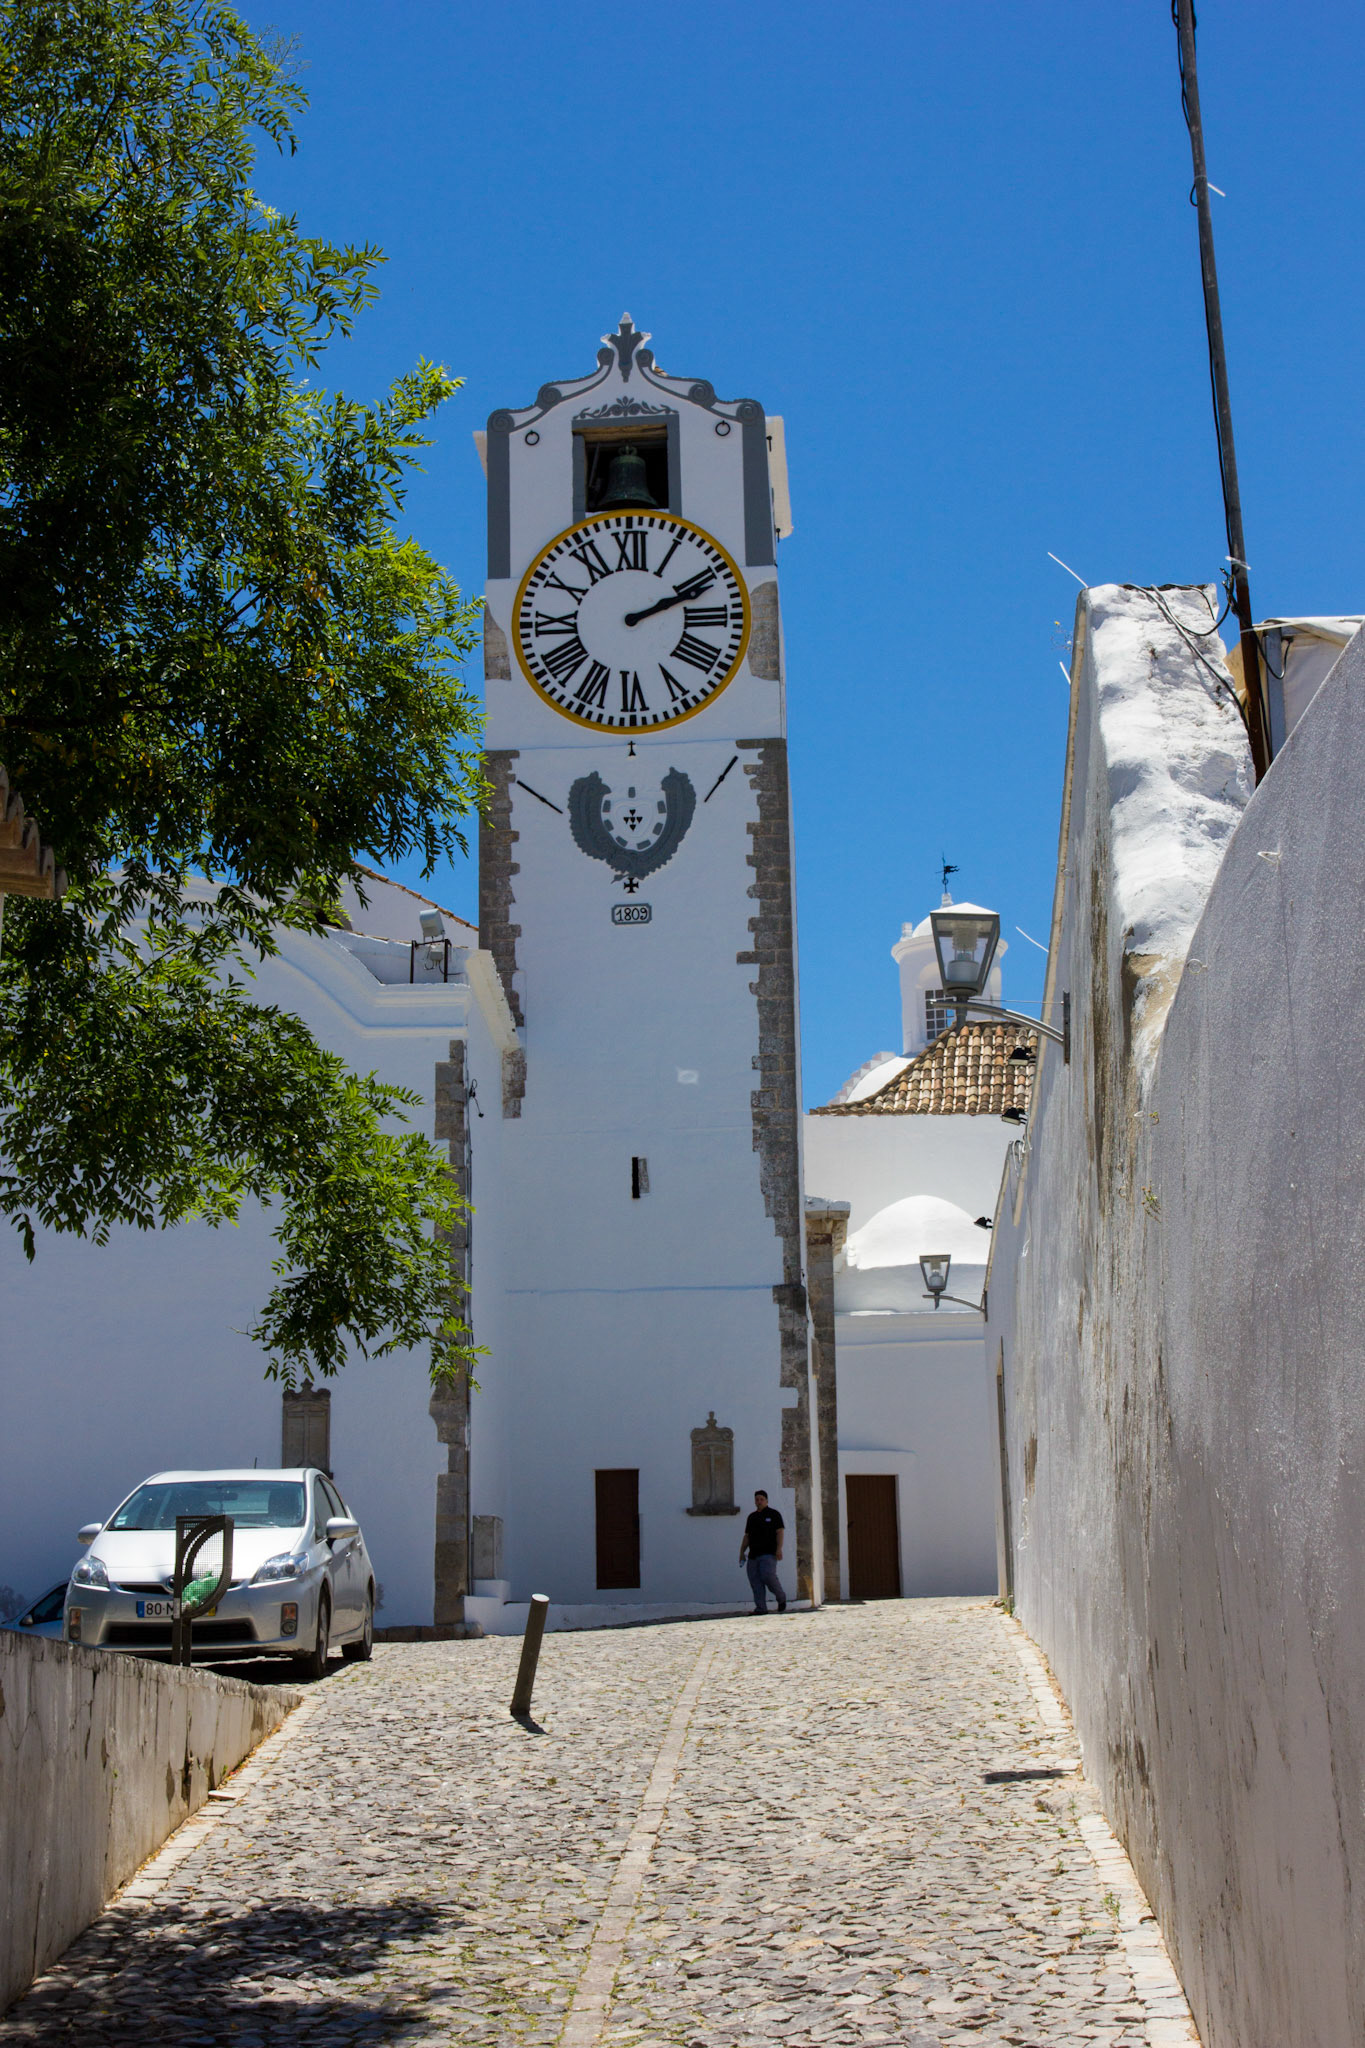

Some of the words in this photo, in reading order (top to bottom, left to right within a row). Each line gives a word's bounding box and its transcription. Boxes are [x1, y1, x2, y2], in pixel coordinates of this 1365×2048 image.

[569, 539, 614, 586] XI
[611, 531, 649, 572] XII
[653, 538, 682, 578] I
[543, 571, 589, 606] X
[535, 611, 578, 637] IX
[683, 604, 728, 630] III
[540, 635, 590, 688] VIII
[669, 630, 722, 675] IIII
[573, 659, 611, 709] VII
[619, 670, 650, 712] VI
[658, 662, 690, 702] V
[615, 907, 648, 922] 1809
